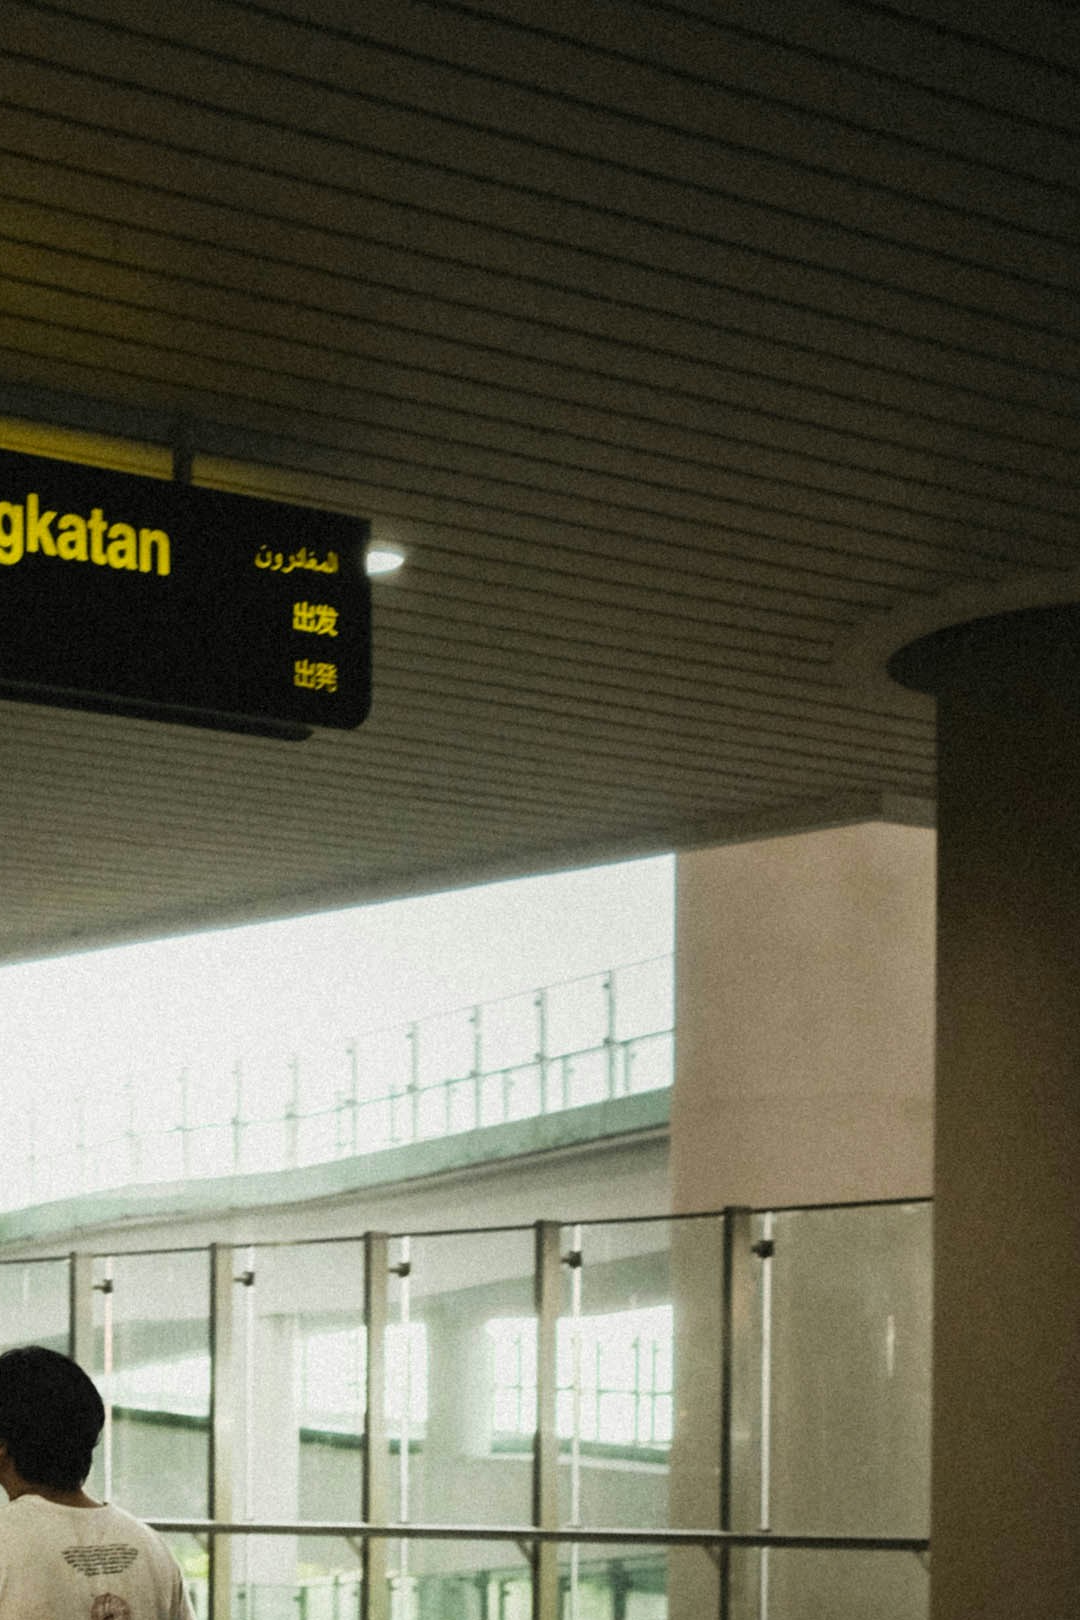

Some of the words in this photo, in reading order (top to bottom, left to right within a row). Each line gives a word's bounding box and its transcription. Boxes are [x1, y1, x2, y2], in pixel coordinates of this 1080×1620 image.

[254, 544, 339, 573] المغادرون
[291, 600, 339, 637] 出发
[293, 658, 338, 693] 出発
